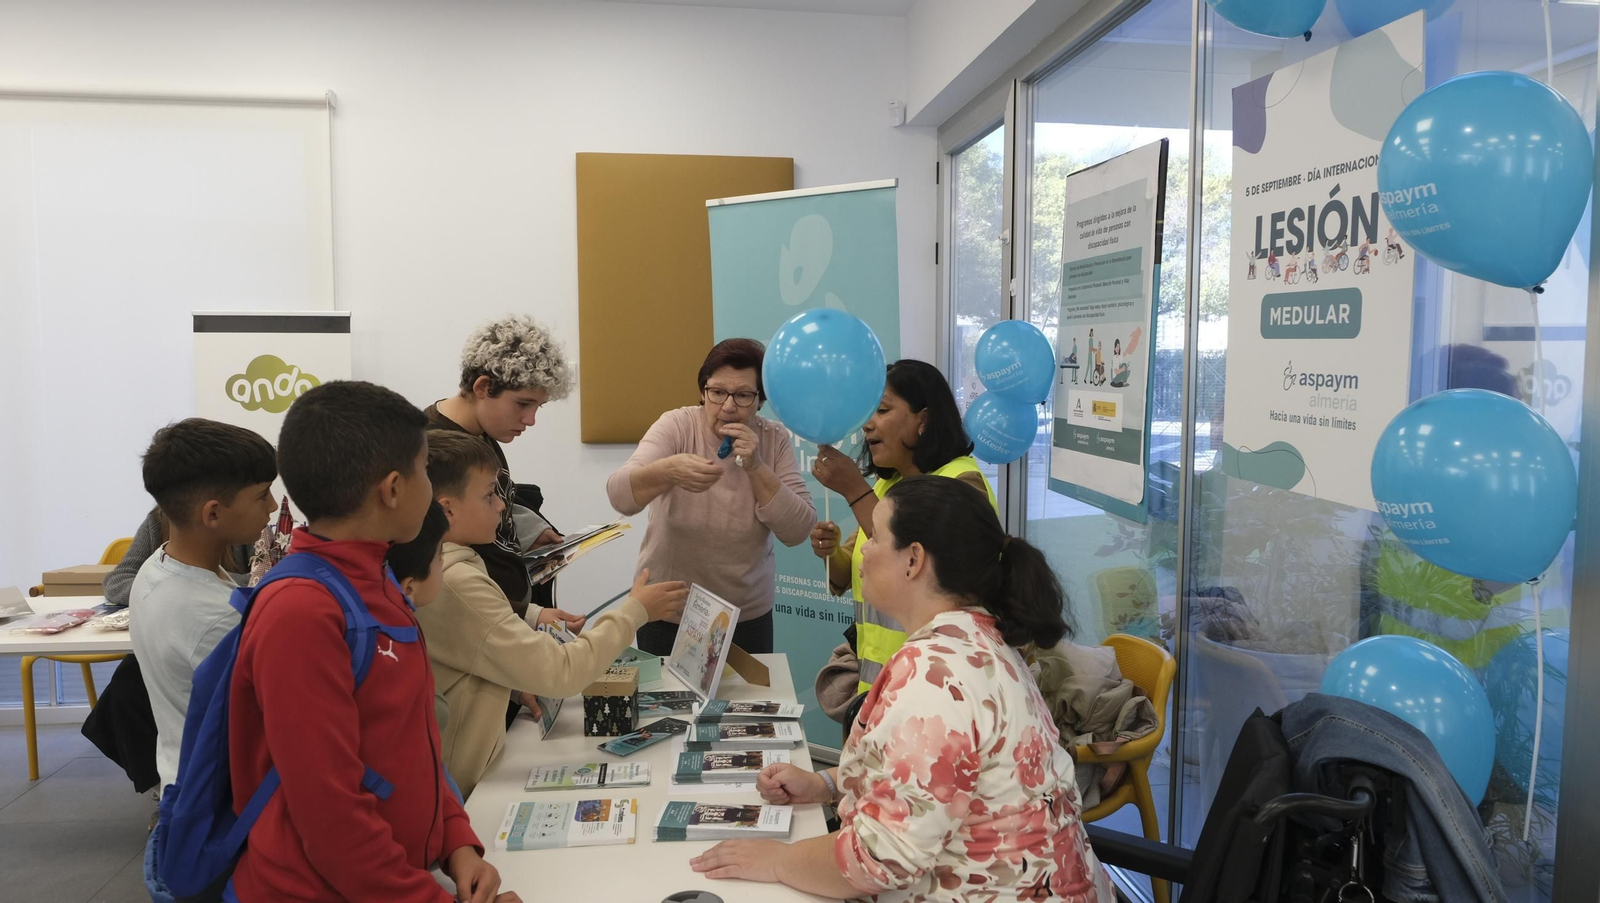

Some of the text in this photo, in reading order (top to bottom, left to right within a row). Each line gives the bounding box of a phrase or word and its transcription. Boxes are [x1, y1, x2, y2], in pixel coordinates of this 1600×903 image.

[1245, 187, 1250, 197] 5
[1251, 185, 1260, 195] DE
[1261, 174, 1302, 194] SEPTIEMBRE
[1307, 167, 1321, 182] DÍA
[1323, 154, 1379, 178] INTERNACION
[1115, 208, 1127, 218] mejora
[1127, 206, 1132, 214] de
[1132, 204, 1137, 212] la
[1103, 226, 1108, 234] de
[1108, 222, 1123, 233] personas
[1255, 182, 1380, 260] LESIÓN
[1269, 303, 1350, 326] MEDULAR
[986, 361, 1022, 379] aspaym
[1299, 372, 1359, 392] aspaym
[1309, 392, 1358, 411] almería
[1269, 410, 1357, 431] Hacia una vida sin límites
[1377, 501, 1434, 519] spaym
[778, 574, 811, 587] PERSONAS
[813, 580, 827, 589] CON
[781, 587, 835, 603] DISCAPACIDADES
[775, 603, 856, 625] una vida sin lími
